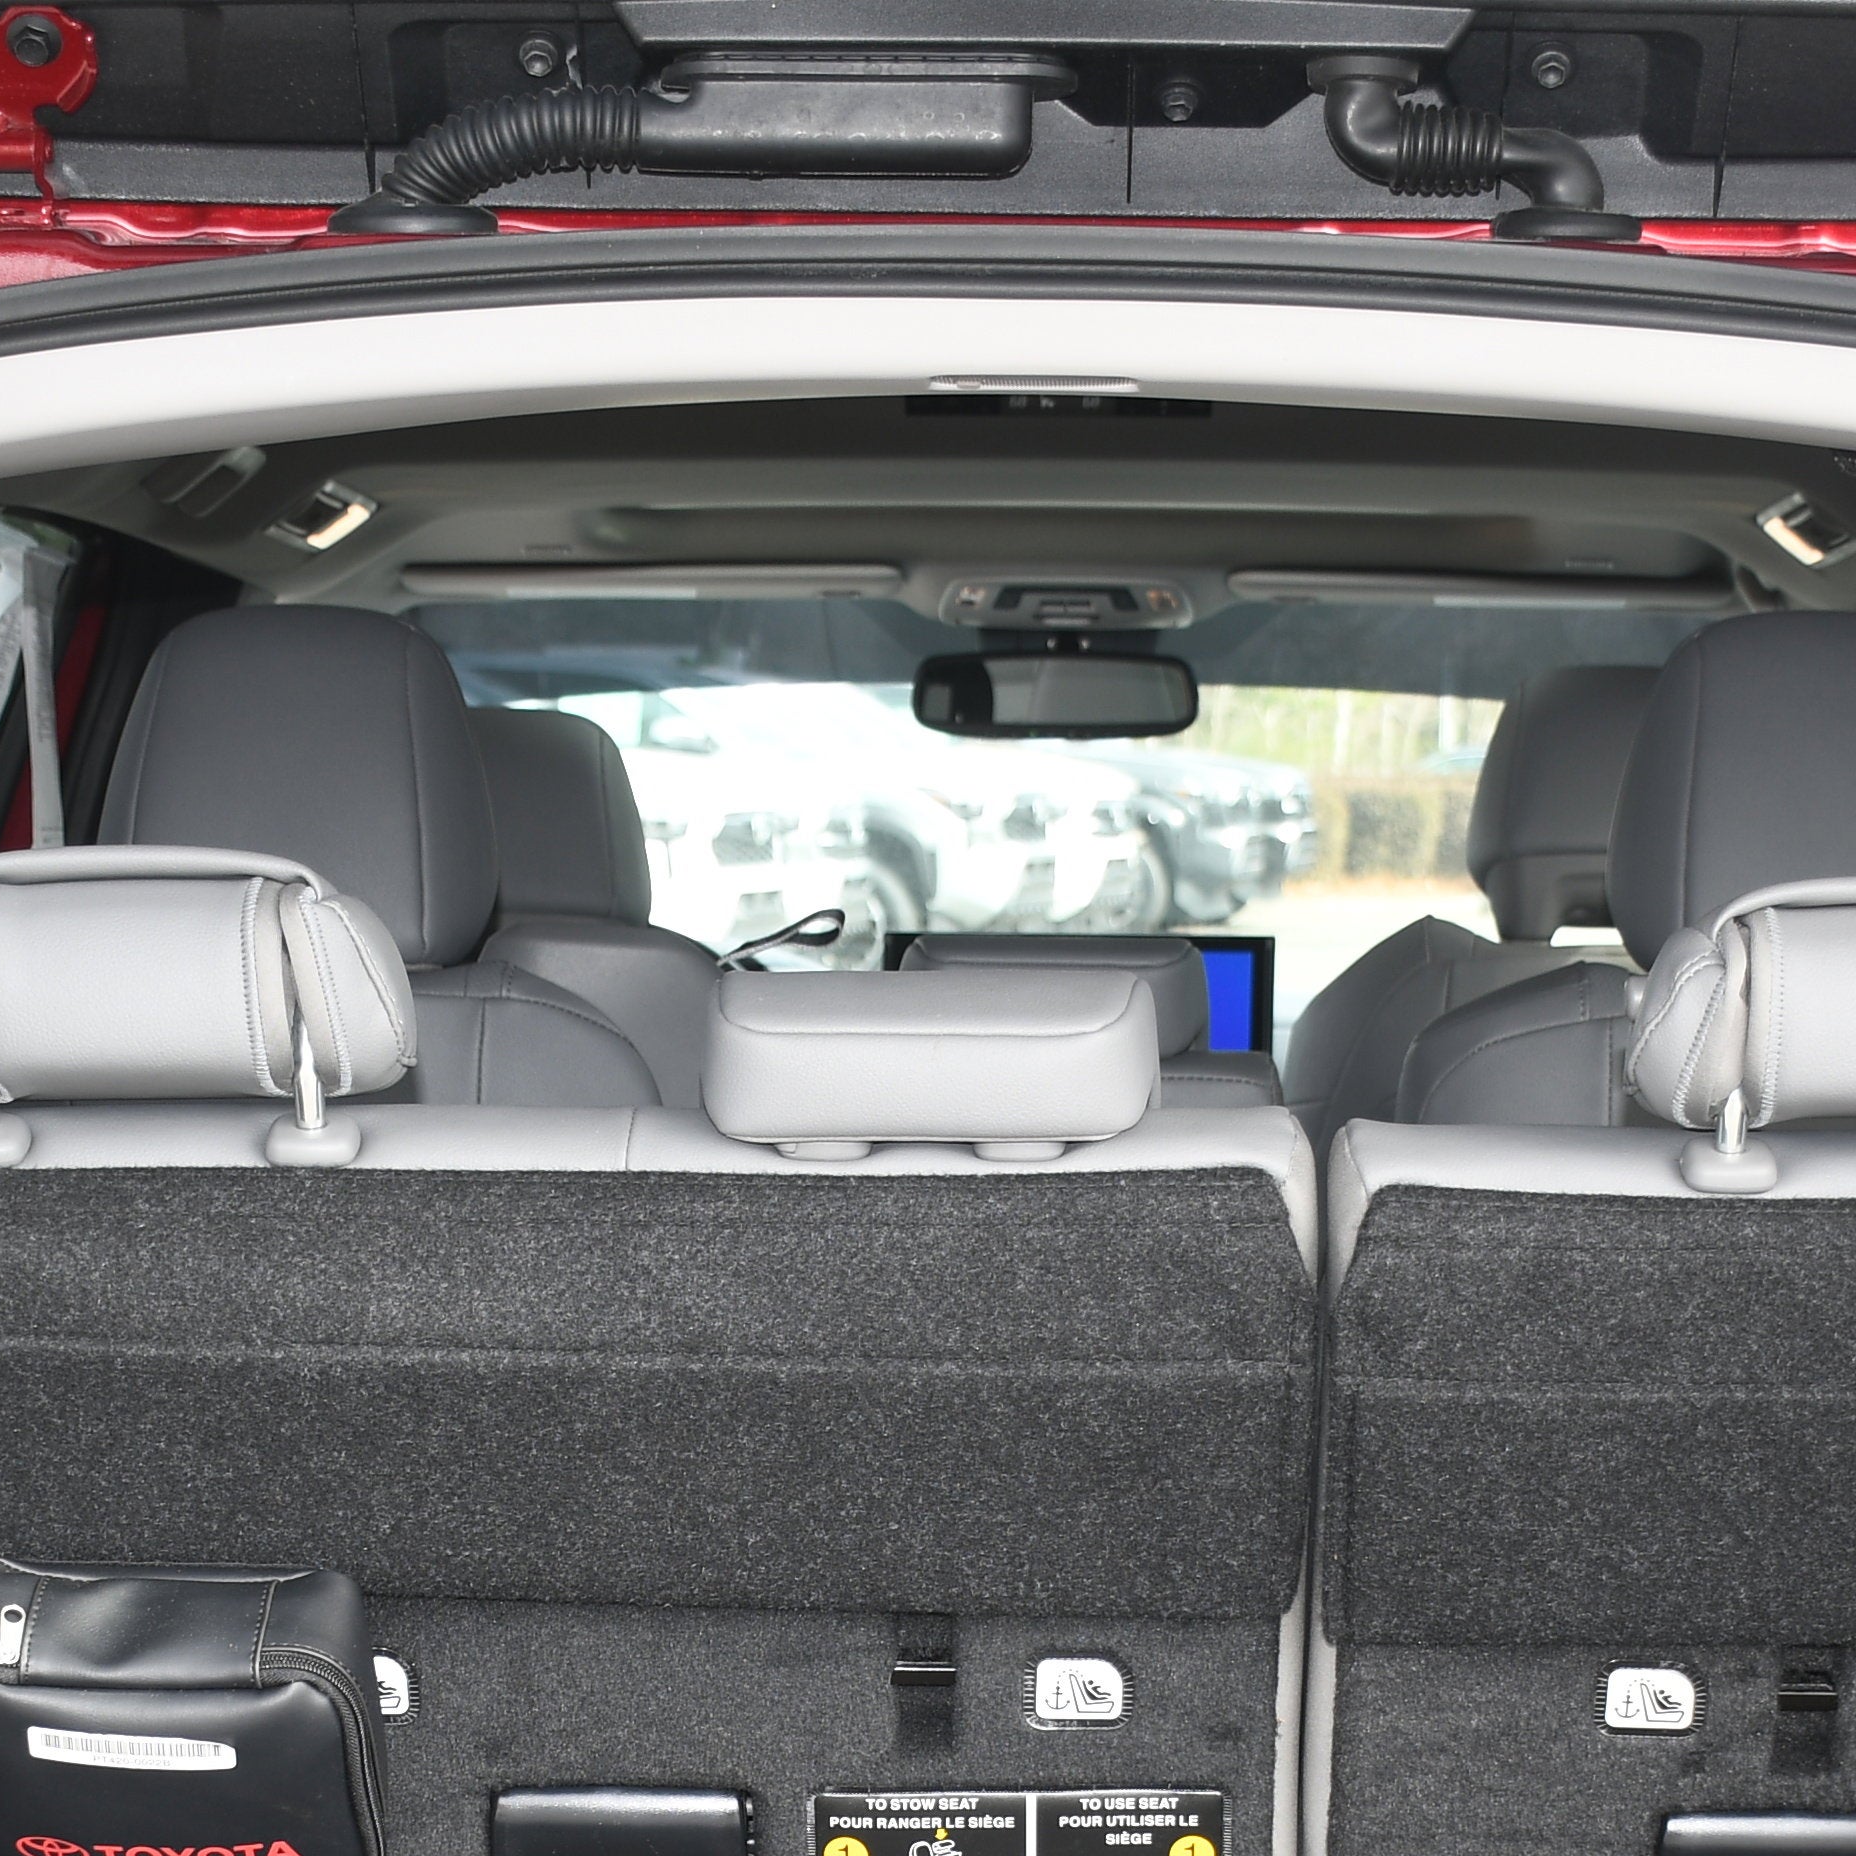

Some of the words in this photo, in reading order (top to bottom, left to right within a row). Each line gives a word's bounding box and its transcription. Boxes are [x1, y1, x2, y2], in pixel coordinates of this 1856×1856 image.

[865, 1798, 888, 1811] TO
[890, 1798, 937, 1811] STOW
[938, 1797, 980, 1810] SEAT
[1079, 1798, 1102, 1811] TO
[1104, 1798, 1136, 1811] USE
[1138, 1797, 1179, 1811] SEAT
[829, 1816, 873, 1829] POUR
[876, 1817, 943, 1830] RANGER
[945, 1816, 966, 1829] LE
[968, 1814, 1016, 1829] SIÈGE
[1058, 1815, 1103, 1828] POUR
[1105, 1814, 1176, 1828] UTILISER
[1178, 1814, 1199, 1827] LE
[1105, 1830, 1153, 1845] SIÈGE
